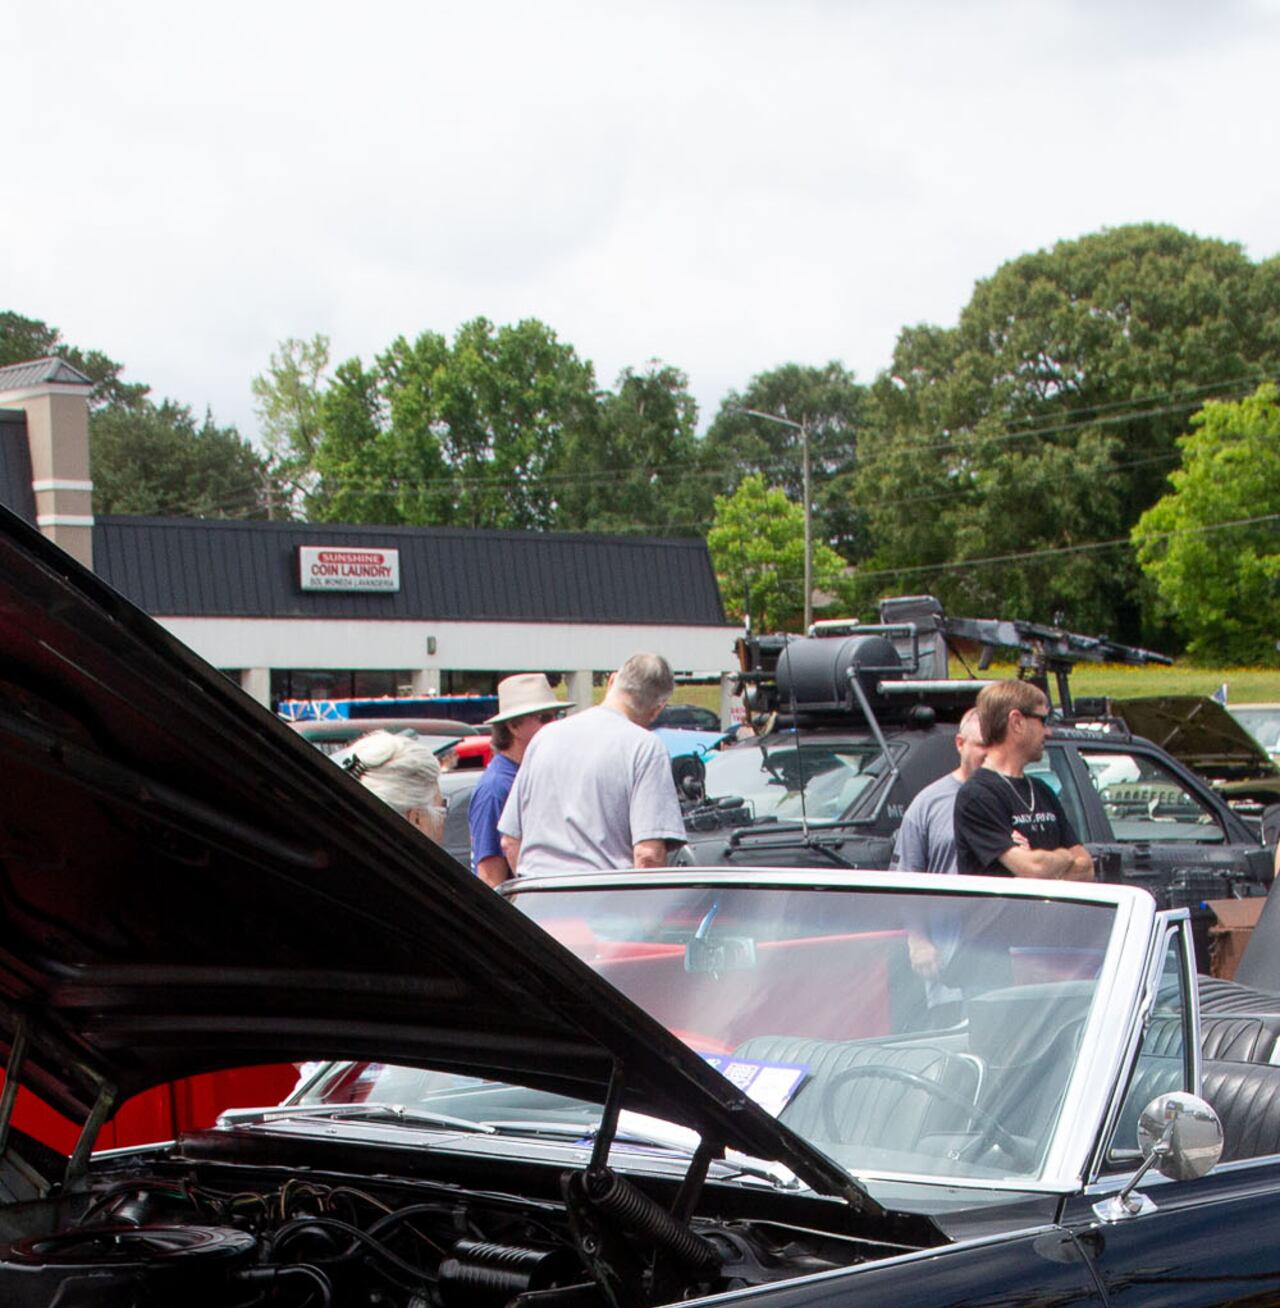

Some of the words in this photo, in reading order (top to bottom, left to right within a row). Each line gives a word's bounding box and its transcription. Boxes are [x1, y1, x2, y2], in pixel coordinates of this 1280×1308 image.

[322, 553, 379, 563] SUNSHINE
[311, 564, 339, 576] COIN
[341, 565, 392, 577] LAUNDRY
